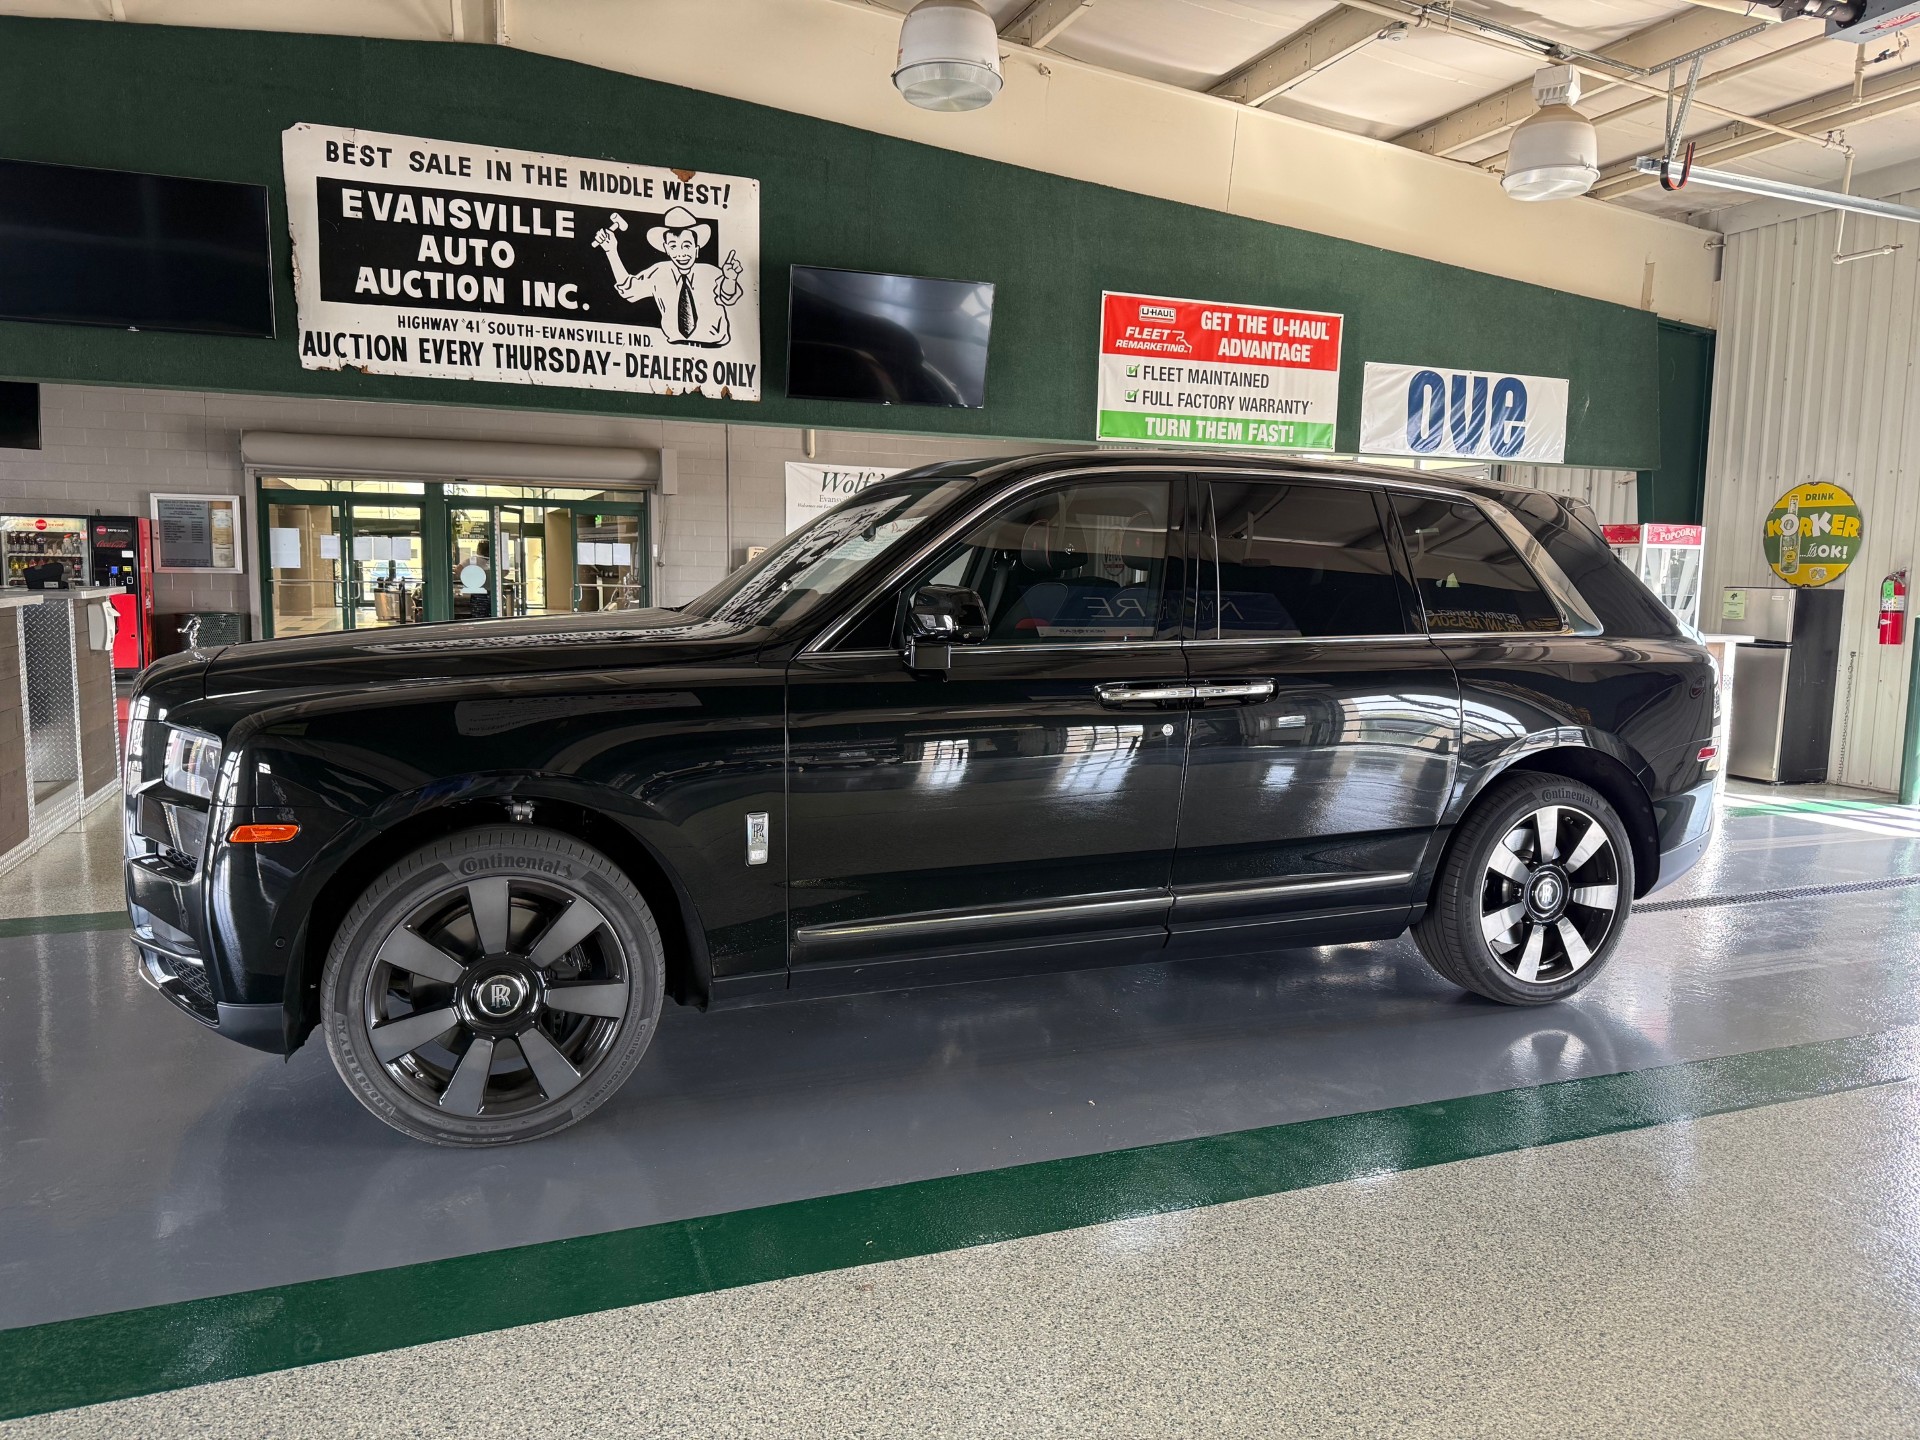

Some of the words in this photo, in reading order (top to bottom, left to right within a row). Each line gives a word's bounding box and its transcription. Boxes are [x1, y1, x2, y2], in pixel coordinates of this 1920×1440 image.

[326, 141, 393, 168] BEST
[409, 151, 471, 177] SALE
[487, 160, 511, 181] IN
[522, 164, 567, 188] THE
[580, 171, 653, 198] MIDDLE
[663, 181, 730, 209] WEST!
[342, 188, 575, 239] EVANSVILLE
[418, 235, 515, 269] AUTO
[355, 267, 505, 304] AUCTION
[523, 280, 590, 311] INC.
[397, 315, 459, 333] HIGHWAY
[628, 333, 654, 348] IND.
[1125, 326, 1171, 341] FLEET
[1201, 310, 1232, 331] GET
[1237, 314, 1267, 335] THE
[302, 331, 408, 362] AUCTION
[418, 338, 484, 367] EVERY
[713, 361, 757, 388] ONLY
[1218, 338, 1311, 363] ADVANTAGE
[1143, 365, 1183, 383] FLEET
[1188, 368, 1269, 389] MAINTAINED
[1142, 390, 1173, 407] FULL
[1177, 393, 1235, 411] FACTORY
[1145, 417, 1191, 437] TURN
[1196, 420, 1243, 440] THEM
[1248, 423, 1294, 443] FAST!
[821, 471, 886, 494] Wolf'
[1805, 493, 1834, 501] DRINK
[1660, 528, 1697, 542] POPCORN
[1767, 511, 1860, 538] KORKER
[1818, 544, 1848, 559] OK!
[1541, 787, 1593, 807] Continental
[458, 853, 561, 876] Continental
